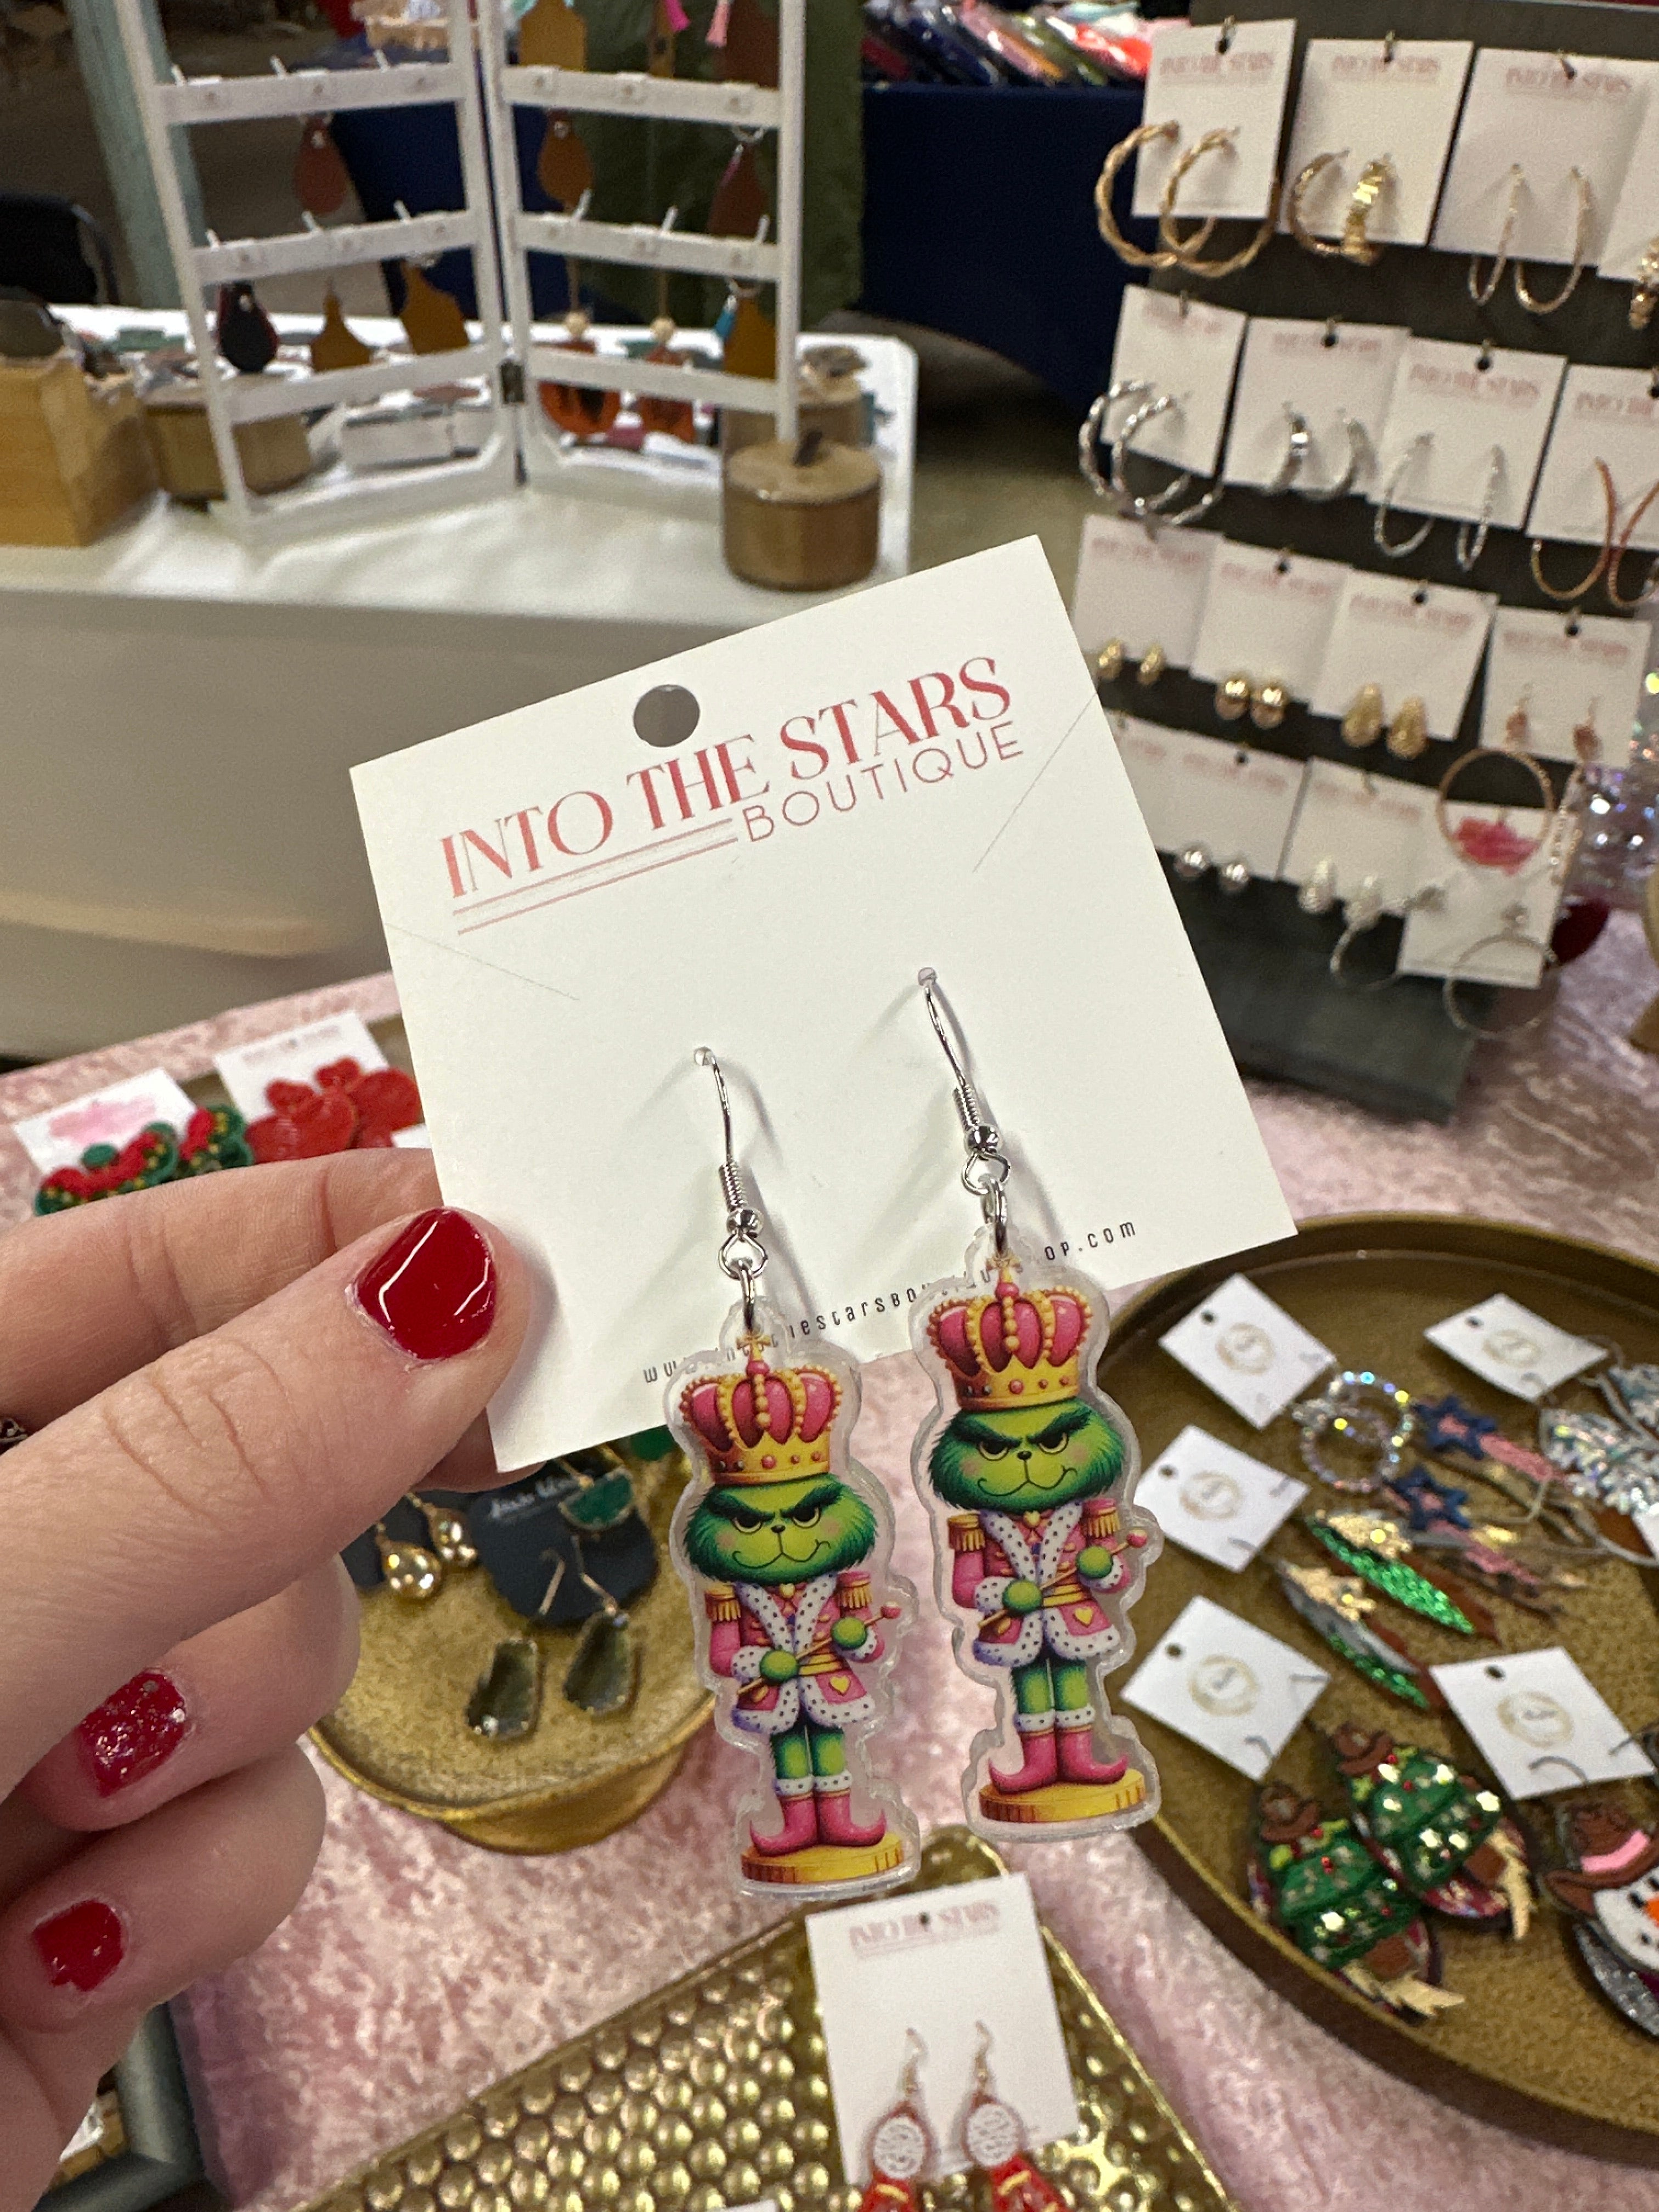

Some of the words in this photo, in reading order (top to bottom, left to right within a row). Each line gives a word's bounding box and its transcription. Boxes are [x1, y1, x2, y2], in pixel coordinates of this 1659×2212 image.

[439, 789, 614, 899] INTO
[626, 733, 770, 830] THE
[779, 656, 1011, 781] STARS
[742, 720, 1024, 843] BOUTIQUE
